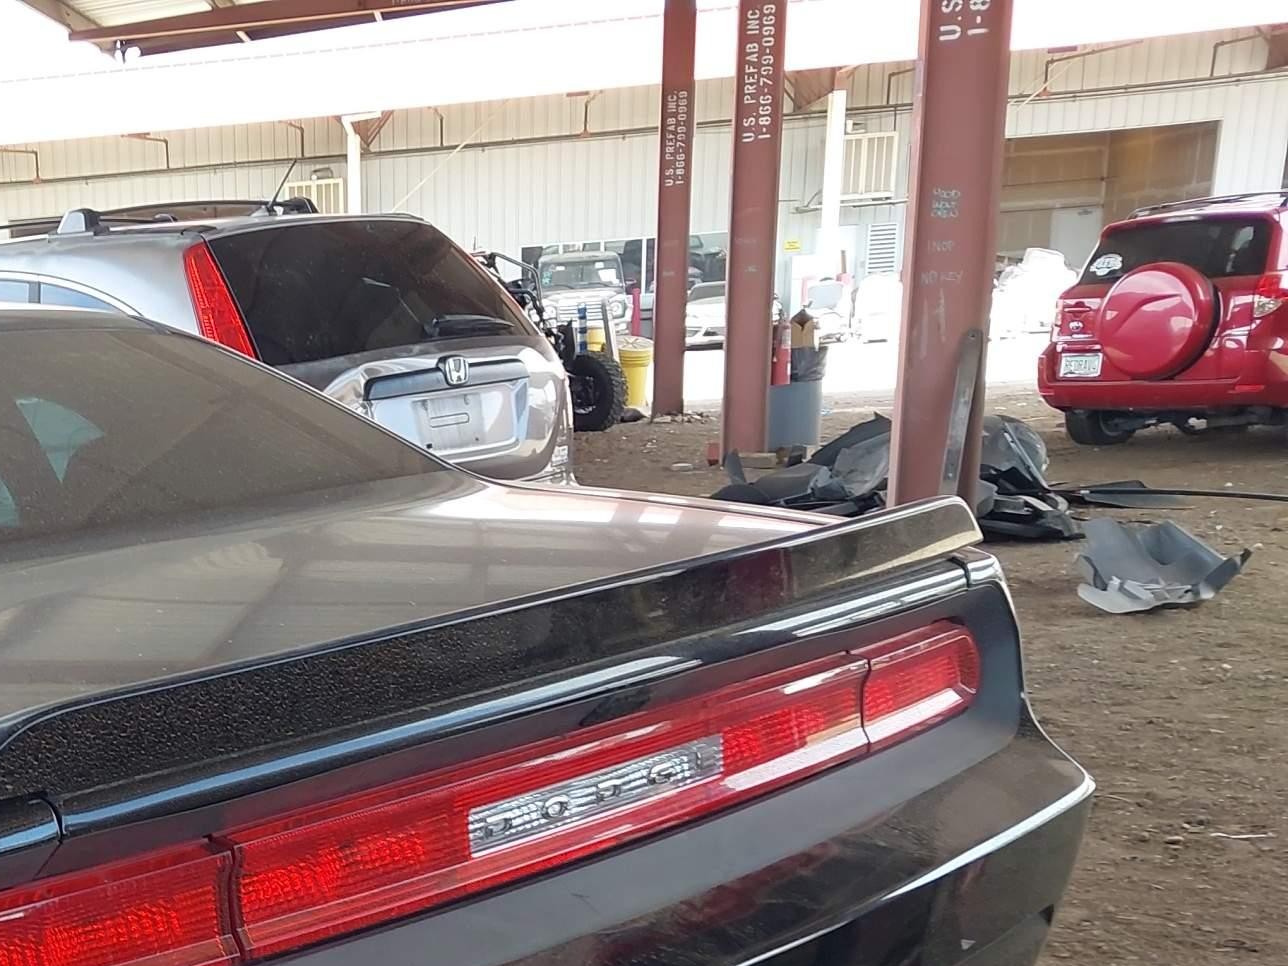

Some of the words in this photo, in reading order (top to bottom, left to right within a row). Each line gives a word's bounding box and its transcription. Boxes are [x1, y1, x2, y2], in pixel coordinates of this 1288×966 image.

[744, 43, 759, 104] PREFAB
[758, 4, 776, 139] 1-866-799-0969
[665, 117, 676, 160] PREFAB
[742, 112, 756, 142] U.S.
[664, 165, 675, 187] U.S.
